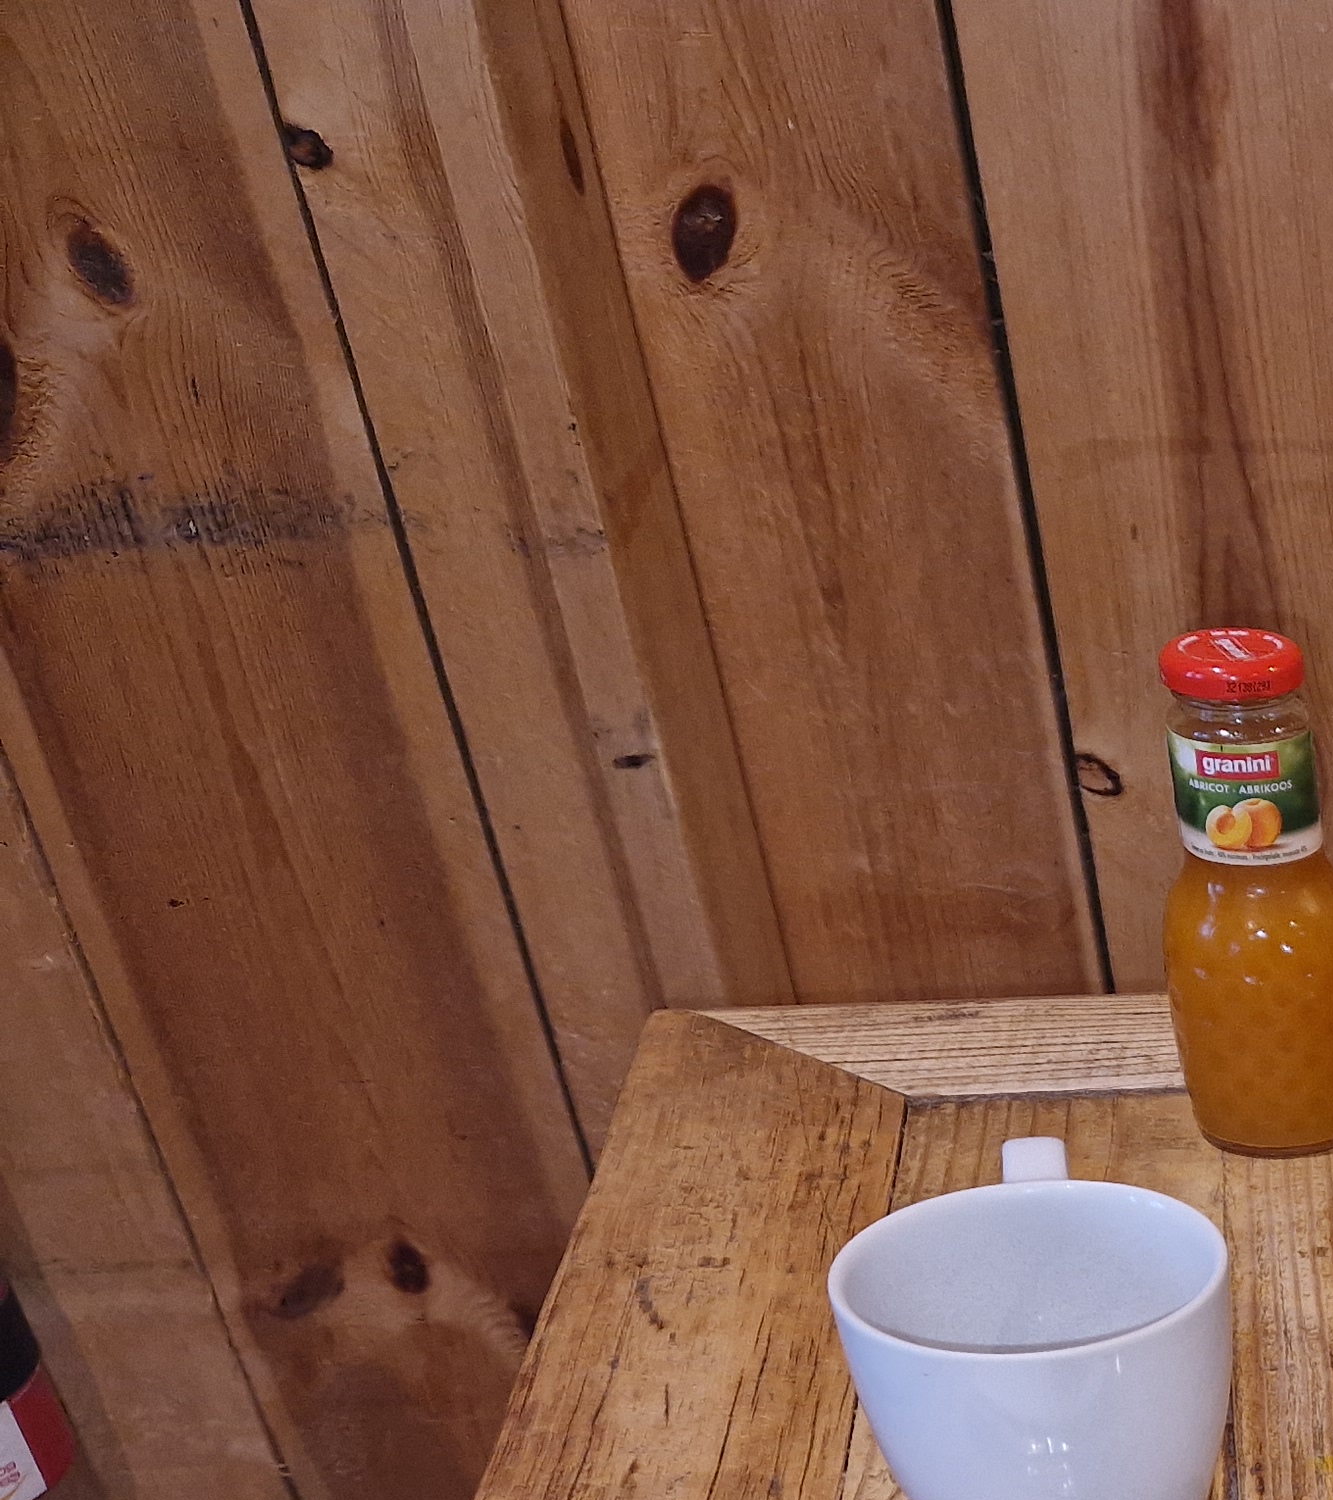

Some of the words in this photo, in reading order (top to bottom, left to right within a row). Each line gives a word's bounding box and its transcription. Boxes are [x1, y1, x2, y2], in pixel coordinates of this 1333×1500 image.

[1202, 755, 1271, 774] granini
[1189, 778, 1229, 793] ABRICOT
[1239, 780, 1293, 794] ABRIKOOS
